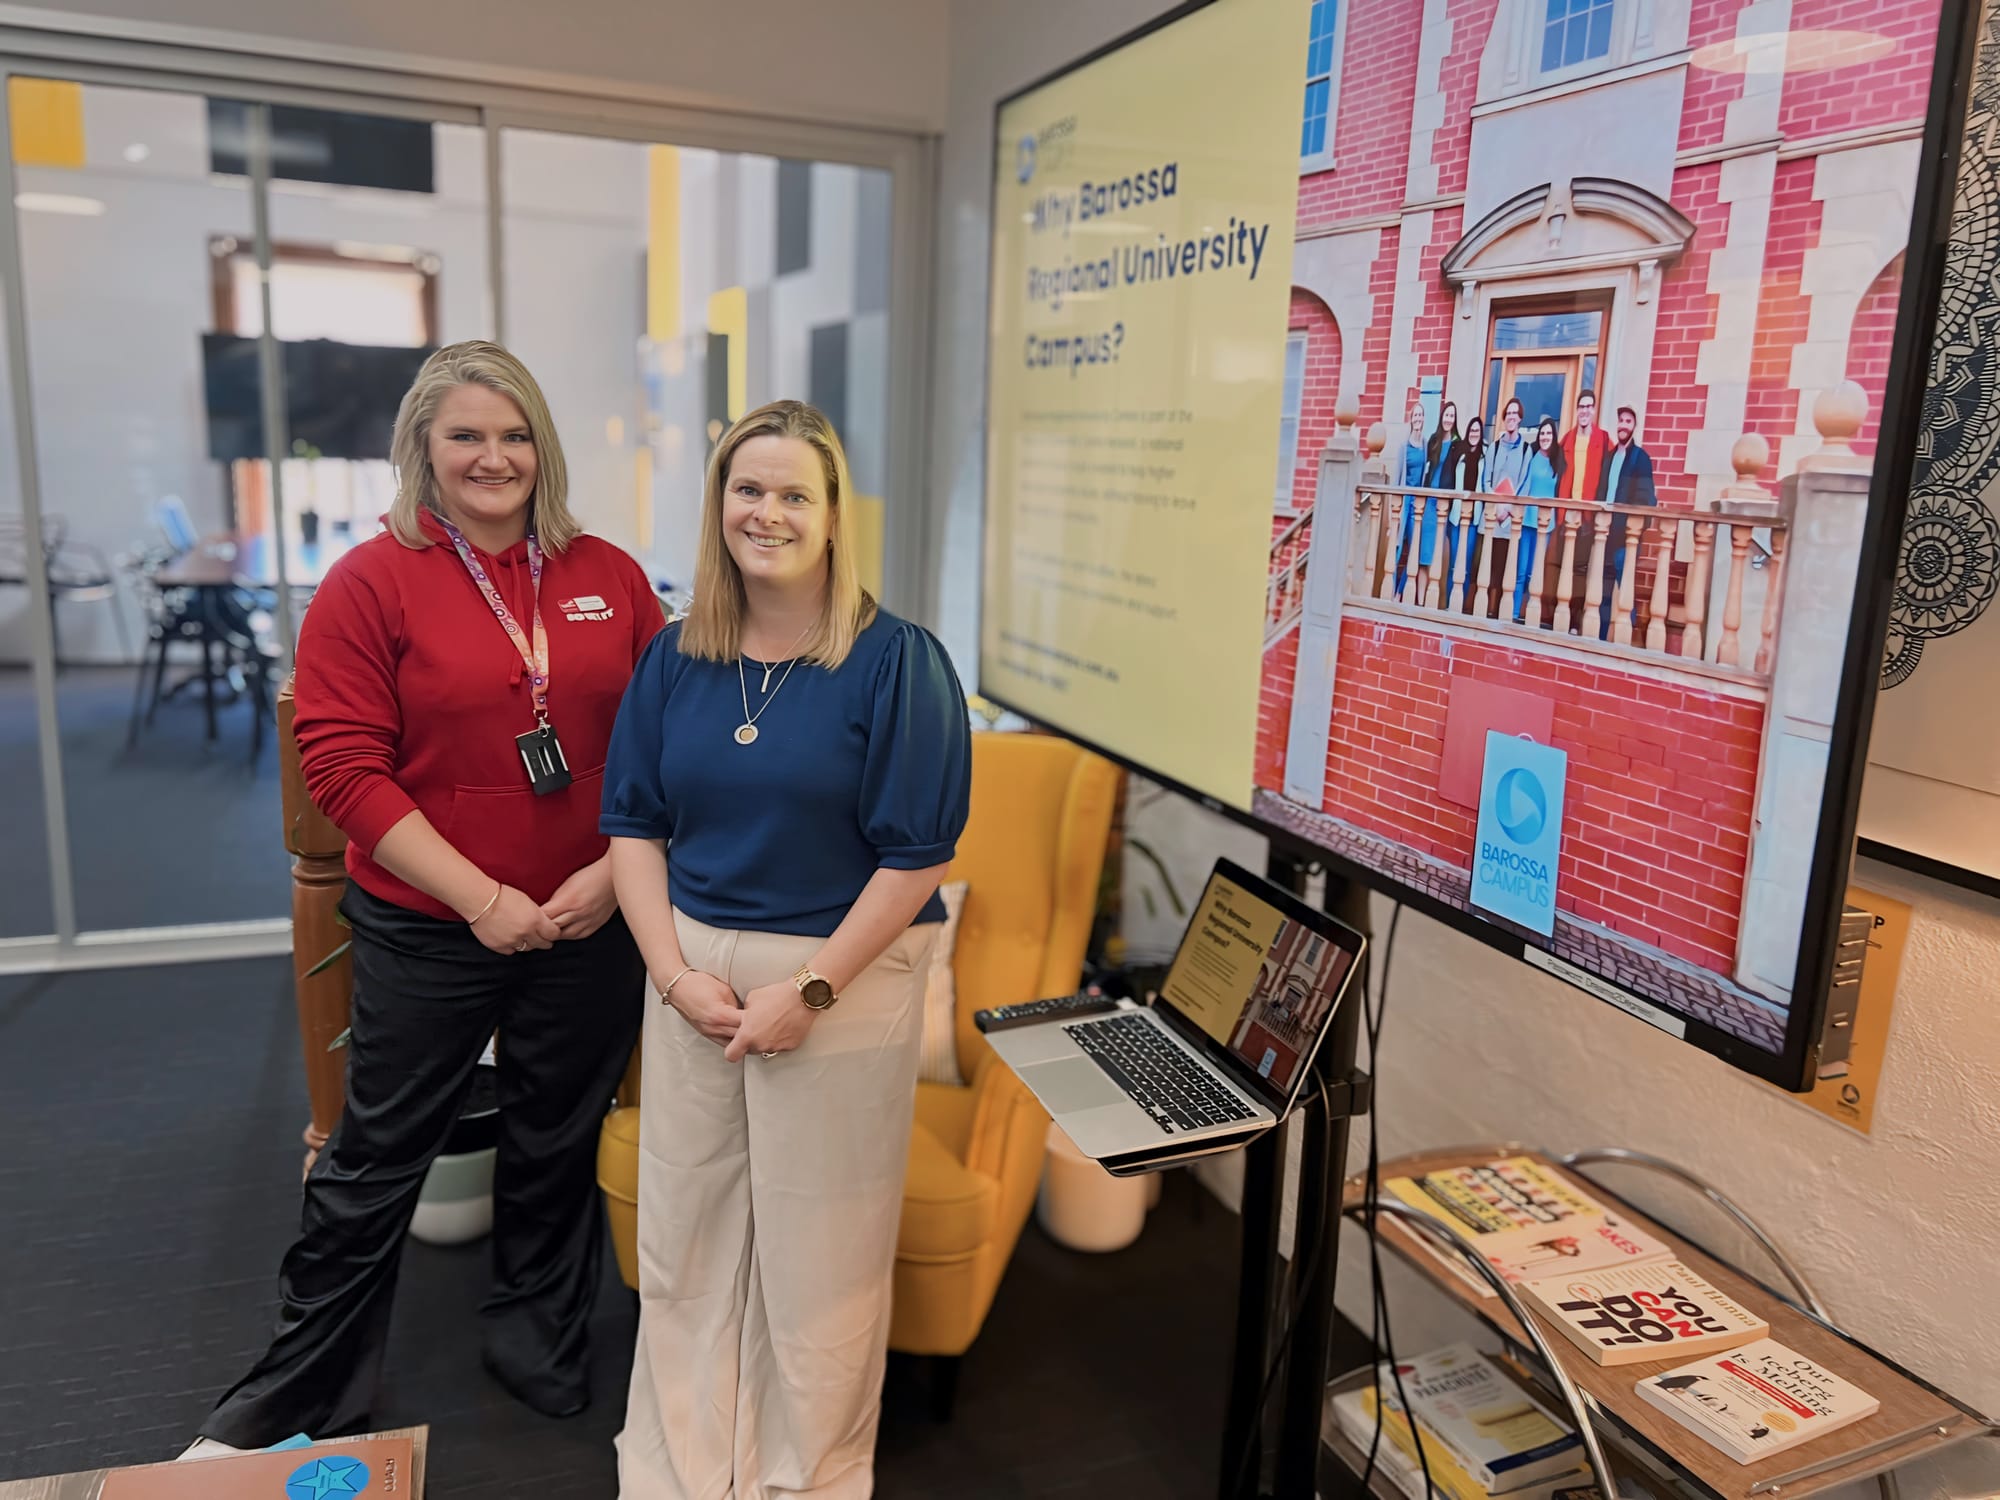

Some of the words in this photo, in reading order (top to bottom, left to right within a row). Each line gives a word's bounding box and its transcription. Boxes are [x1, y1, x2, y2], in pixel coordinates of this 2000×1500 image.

[1080, 162, 1178, 220] Barossa
[1028, 247, 1118, 312] Regional
[1124, 216, 1269, 286] University
[1025, 321, 1125, 379] Campus?
[1479, 862, 1549, 908] CAMPUS
[1481, 841, 1549, 884] BAROSSA
[1631, 1291, 1704, 1338] CAN
[1657, 1286, 1728, 1333] YOU
[1667, 1262, 1702, 1288] Paul
[1703, 1288, 1757, 1327] Hanna
[1557, 1301, 1643, 1346] IT!
[1602, 1295, 1674, 1343] DO
[1731, 1353, 1750, 1367] Is
[1756, 1366, 1835, 1417] Melting
[1759, 1355, 1835, 1401] Iceberg
[1793, 1359, 1835, 1385] Our
